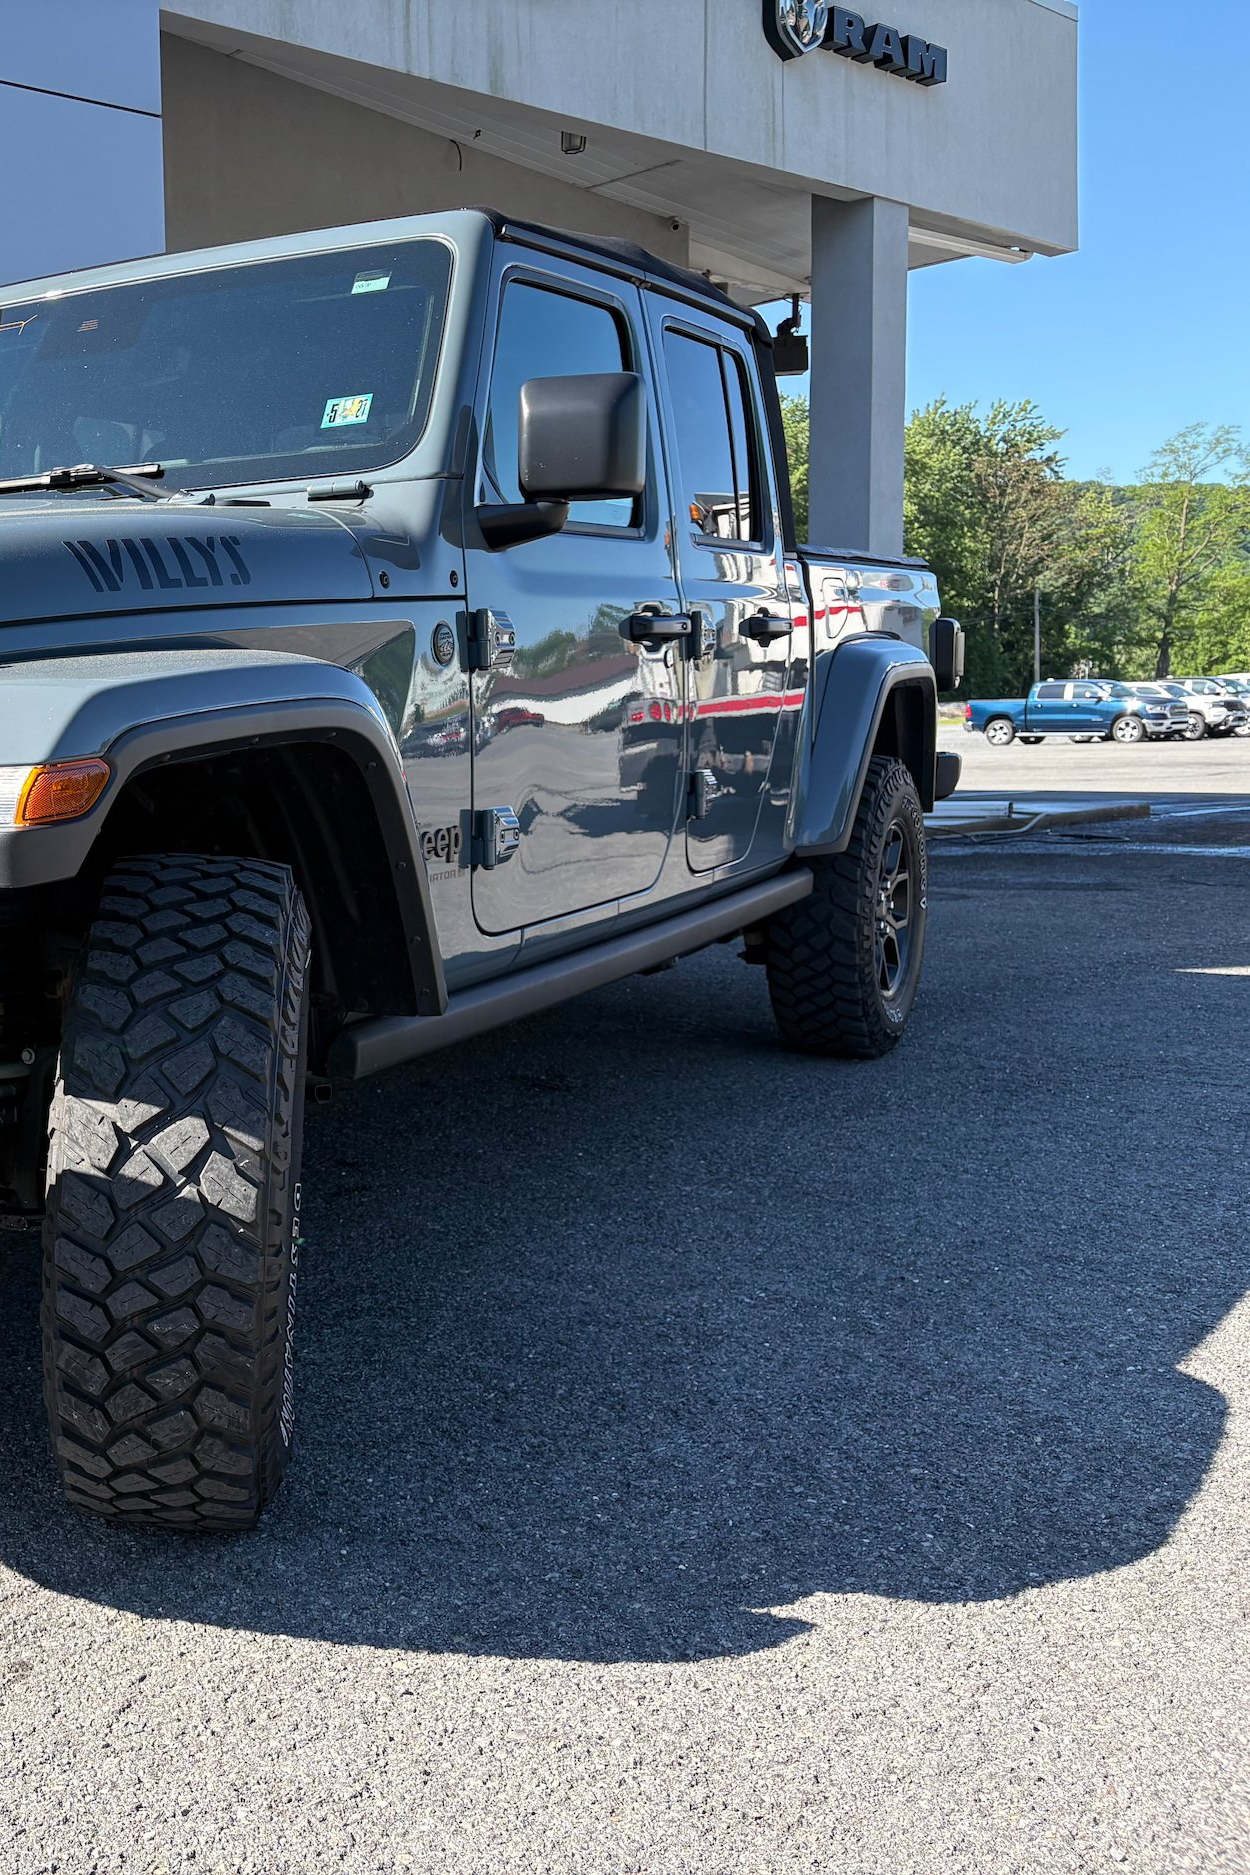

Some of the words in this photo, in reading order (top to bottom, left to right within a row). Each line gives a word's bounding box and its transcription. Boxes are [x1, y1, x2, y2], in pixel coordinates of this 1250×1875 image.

[826, 6, 948, 86] RAM
[61, 536, 252, 593] WILLYS
[421, 825, 463, 863] eep
[429, 869, 457, 883] IATOR
